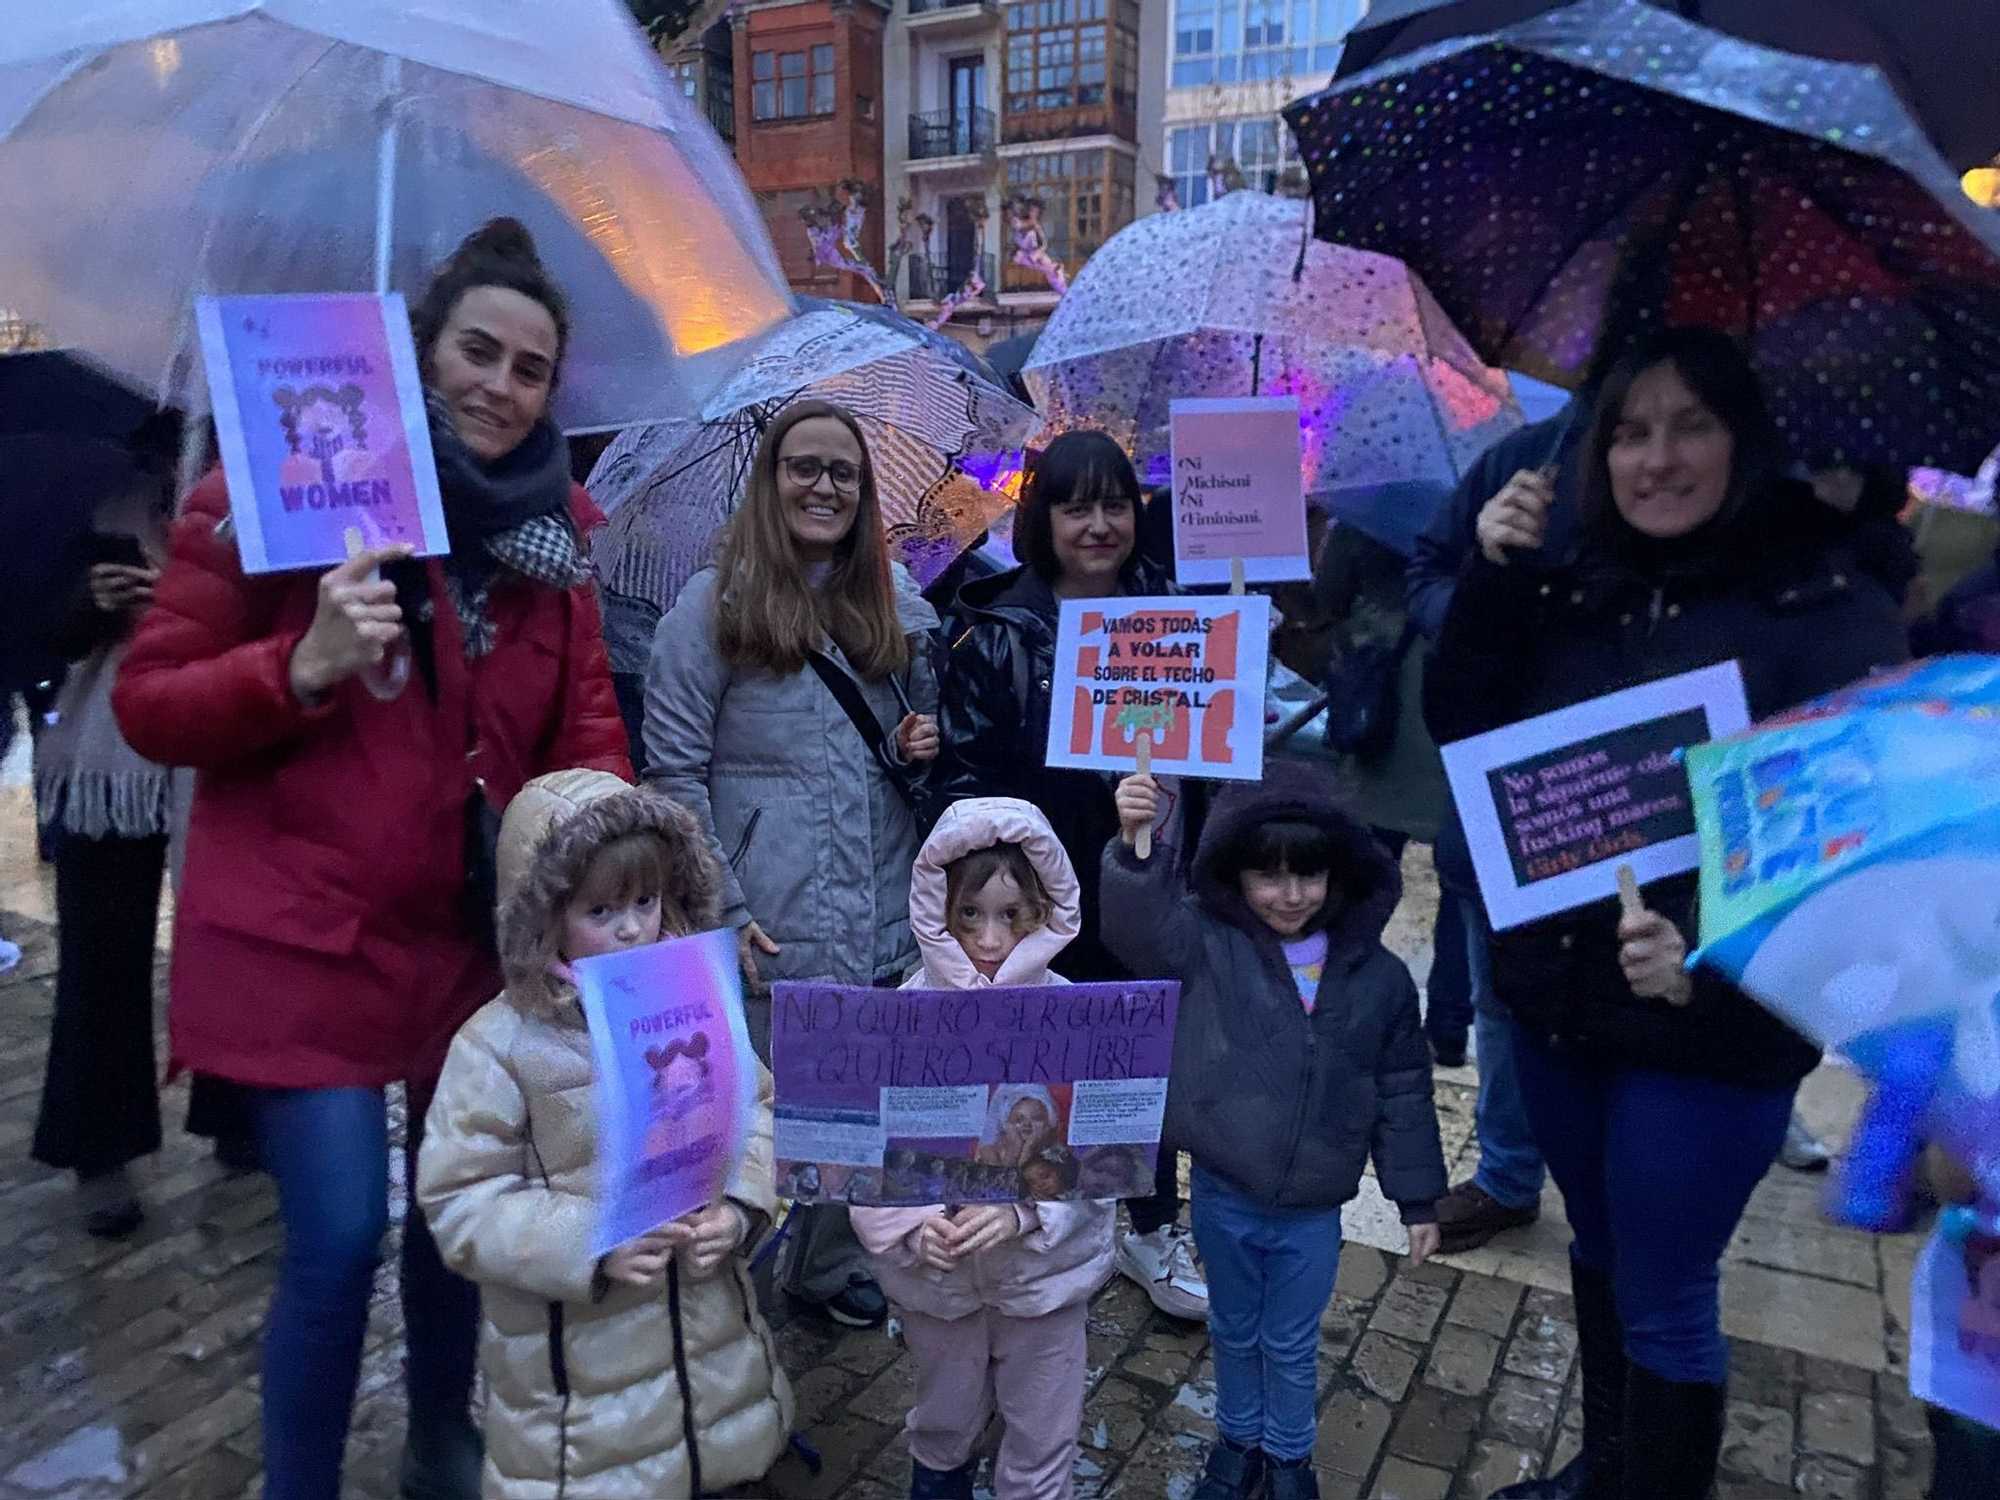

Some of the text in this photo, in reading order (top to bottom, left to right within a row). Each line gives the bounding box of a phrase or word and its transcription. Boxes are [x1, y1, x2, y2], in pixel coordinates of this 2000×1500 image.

[258, 354, 373, 378] POWERFUL
[279, 479, 393, 513] WOMEN
[1101, 616, 1213, 634] VAMOS TODAS
[1108, 641, 1201, 658] A VOLAR
[1093, 665, 1215, 683] SOBRE EL TECHO
[1092, 689, 1213, 708] DE CRISTAL.
[629, 1001, 715, 1039] POWERFUL
[782, 988, 1166, 1036] NO QUIERO SER GUAPA
[816, 1037, 972, 1087] QUIERO
[985, 1037, 1051, 1083] SER
